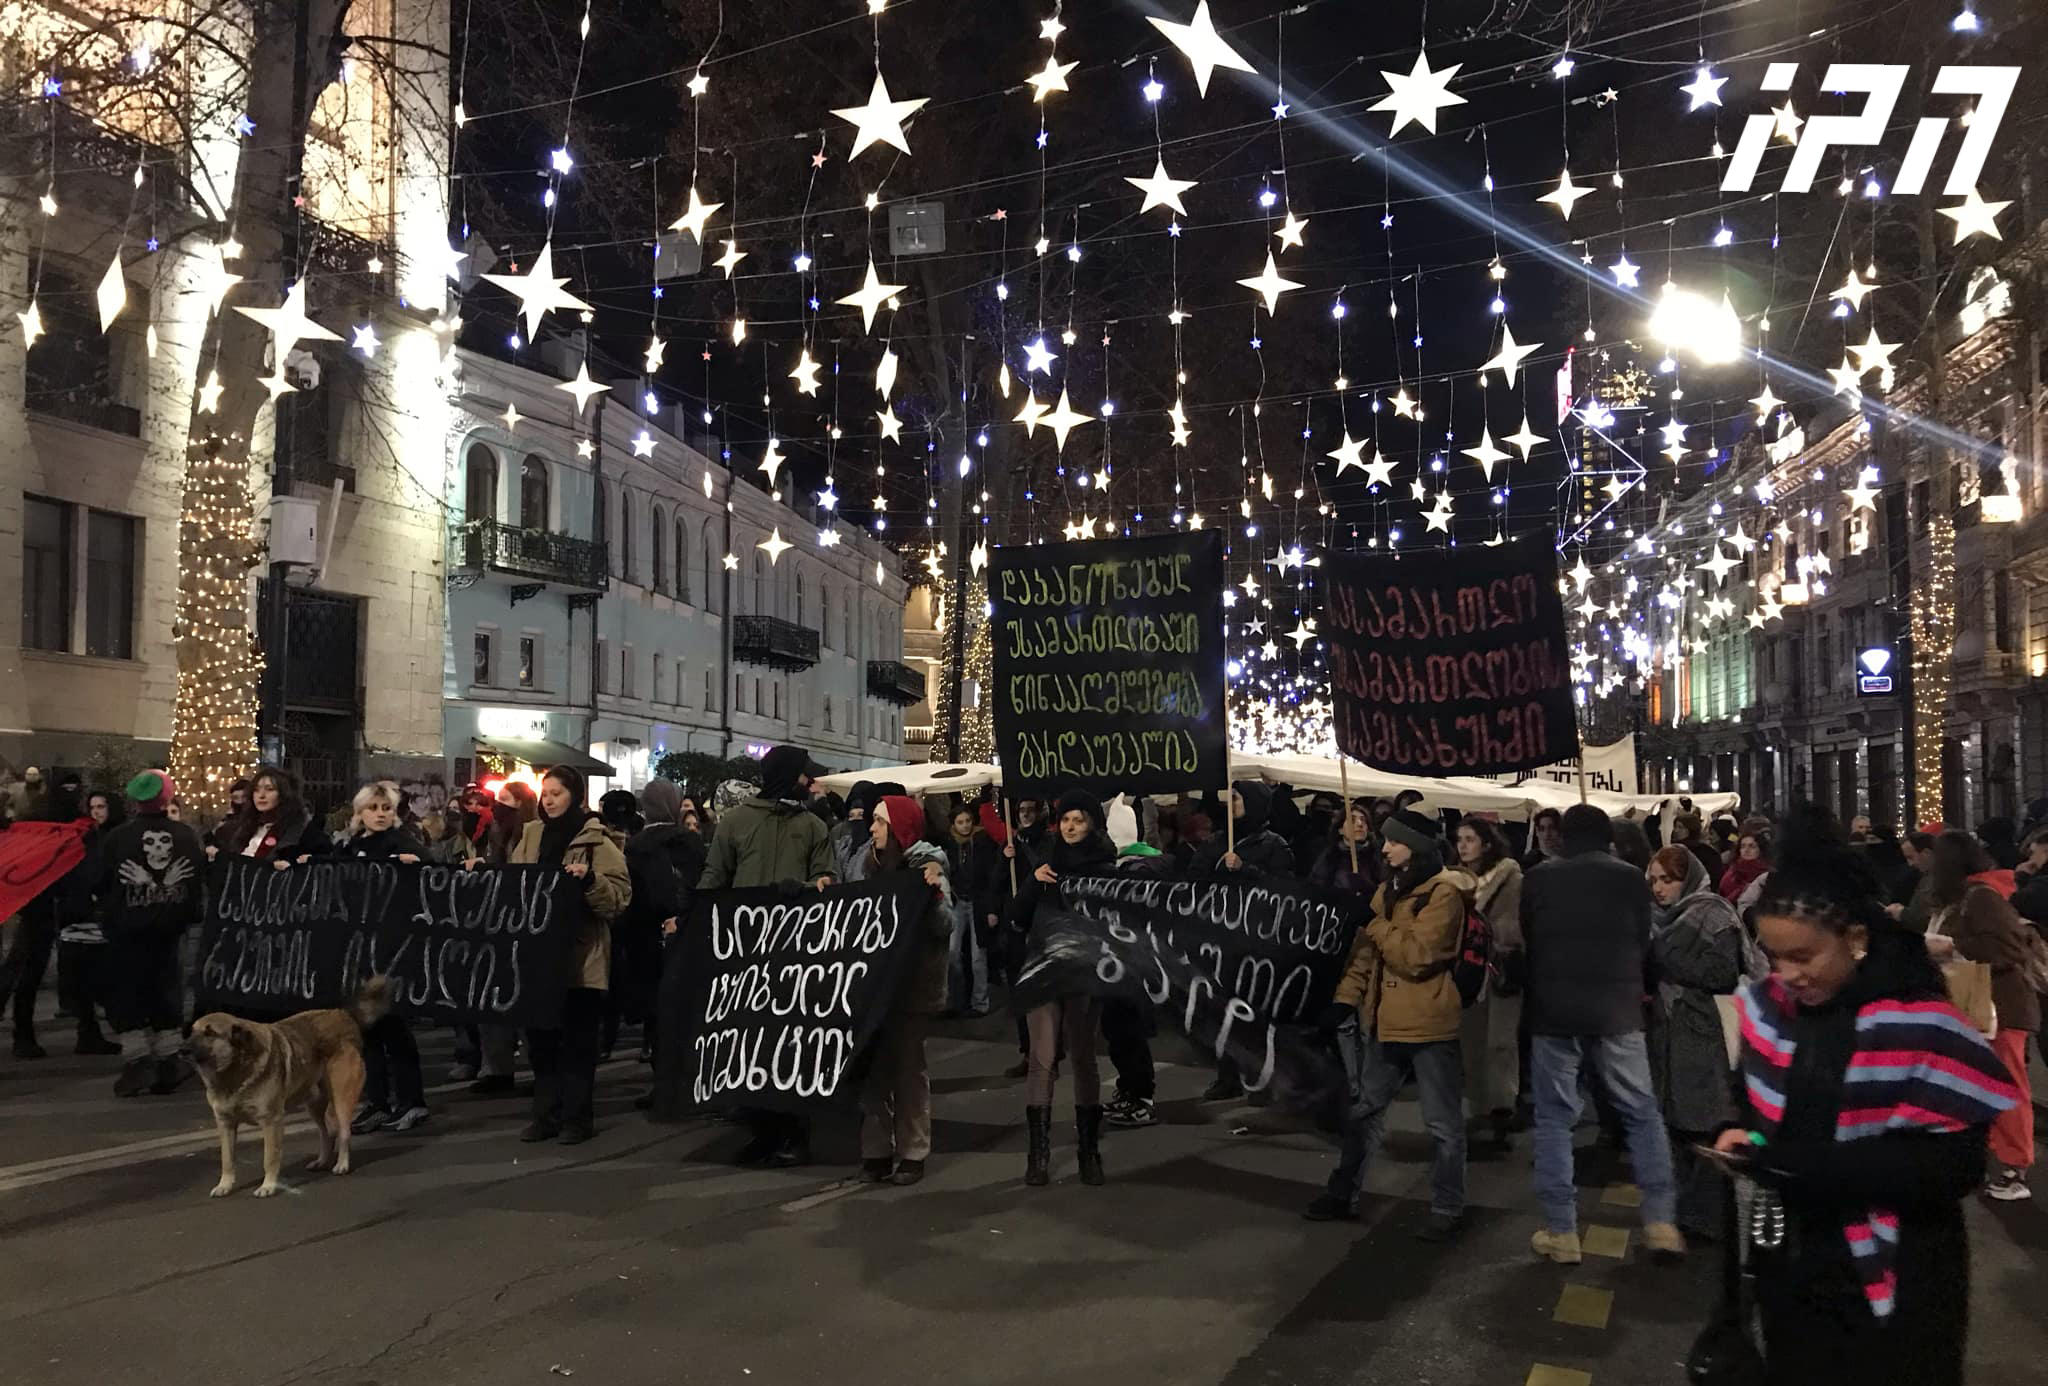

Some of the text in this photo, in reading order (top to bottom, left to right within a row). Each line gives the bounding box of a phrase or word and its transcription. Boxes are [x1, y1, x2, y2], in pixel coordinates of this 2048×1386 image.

[1001, 553, 1192, 606] დაკანონებულ
[1006, 612, 1200, 659] უსამართლობაში
[1010, 666, 1205, 718] წინააღმდეგობა
[1017, 729, 1199, 778] გარდაუვალია
[1346, 701, 1547, 767] სამსახურში
[411, 864, 560, 935] დღესაც
[711, 893, 899, 961] სოლიდარობა
[705, 959, 868, 1024] ტყიბულელ
